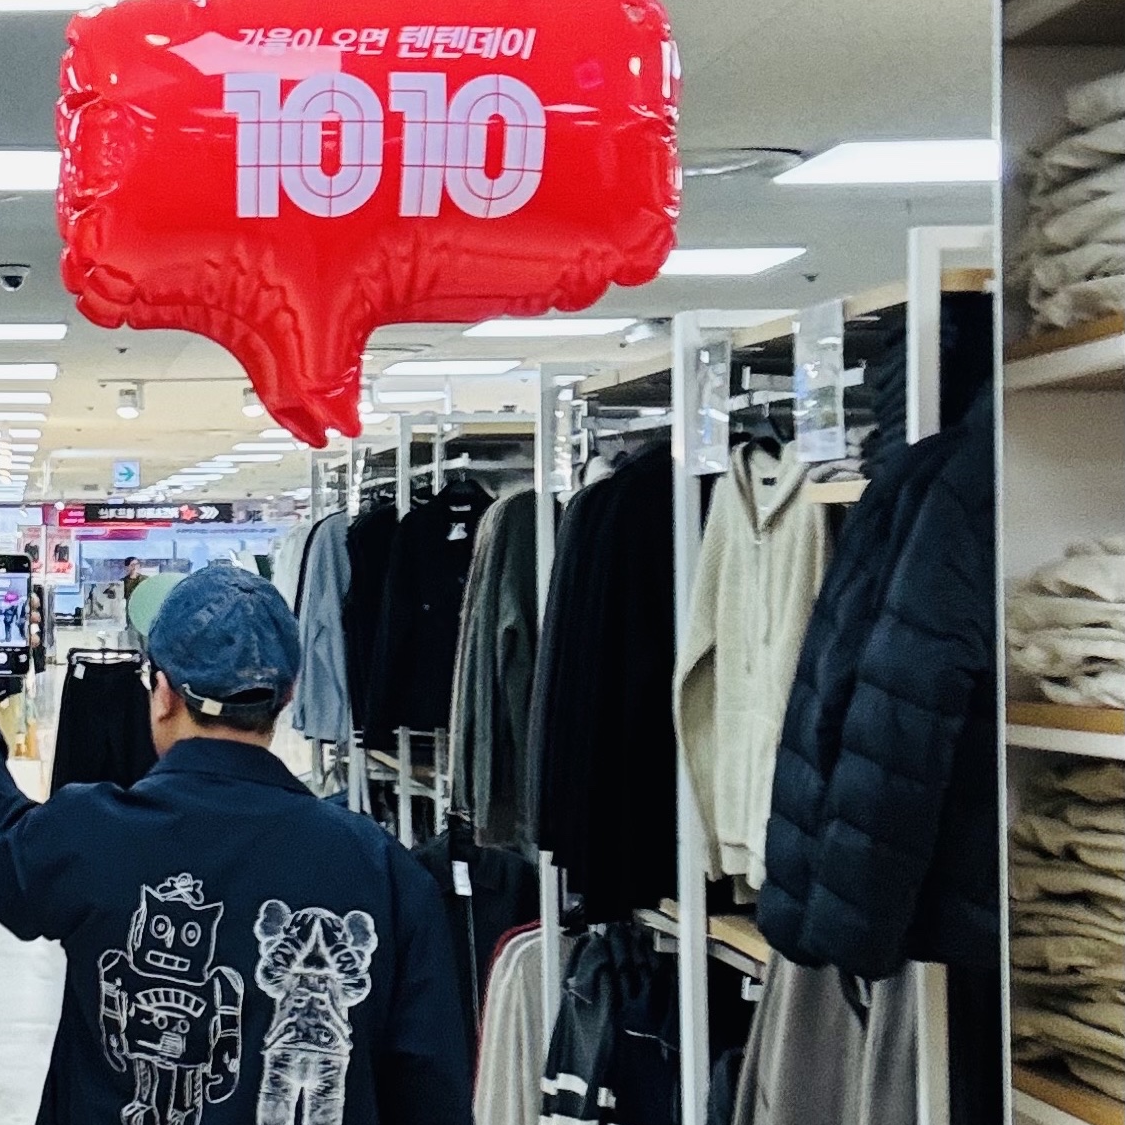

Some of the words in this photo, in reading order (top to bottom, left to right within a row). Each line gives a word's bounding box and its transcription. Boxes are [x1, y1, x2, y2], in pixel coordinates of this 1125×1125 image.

[237, 27, 324, 56] 가을이
[332, 27, 390, 55] 오면
[396, 25, 537, 60] 텐텐데이
